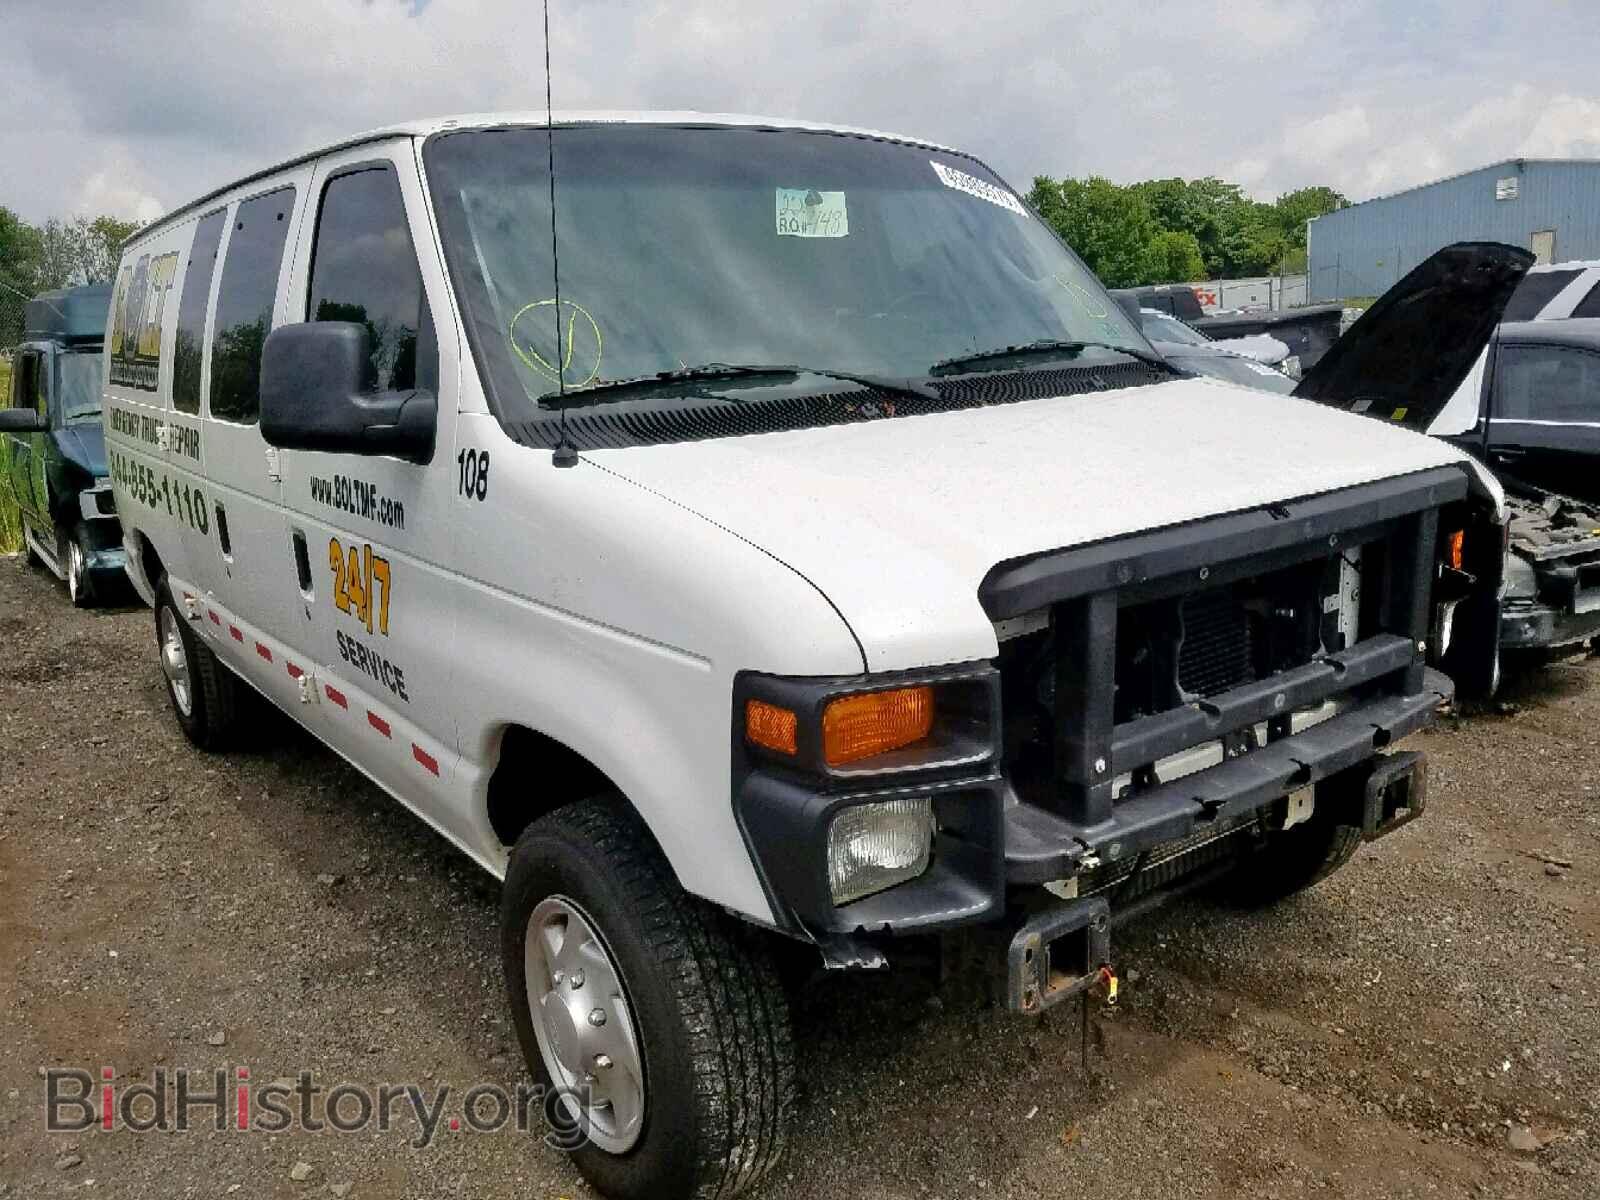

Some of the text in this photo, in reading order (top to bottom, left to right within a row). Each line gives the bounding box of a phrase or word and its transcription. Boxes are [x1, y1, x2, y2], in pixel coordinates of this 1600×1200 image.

[169, 422, 200, 462] REPAIR
[310, 474, 405, 530] www.BOLTMF.com
[457, 448, 490, 502] 108
[328, 537, 392, 637] 24/7
[336, 630, 410, 704] SERVICE
